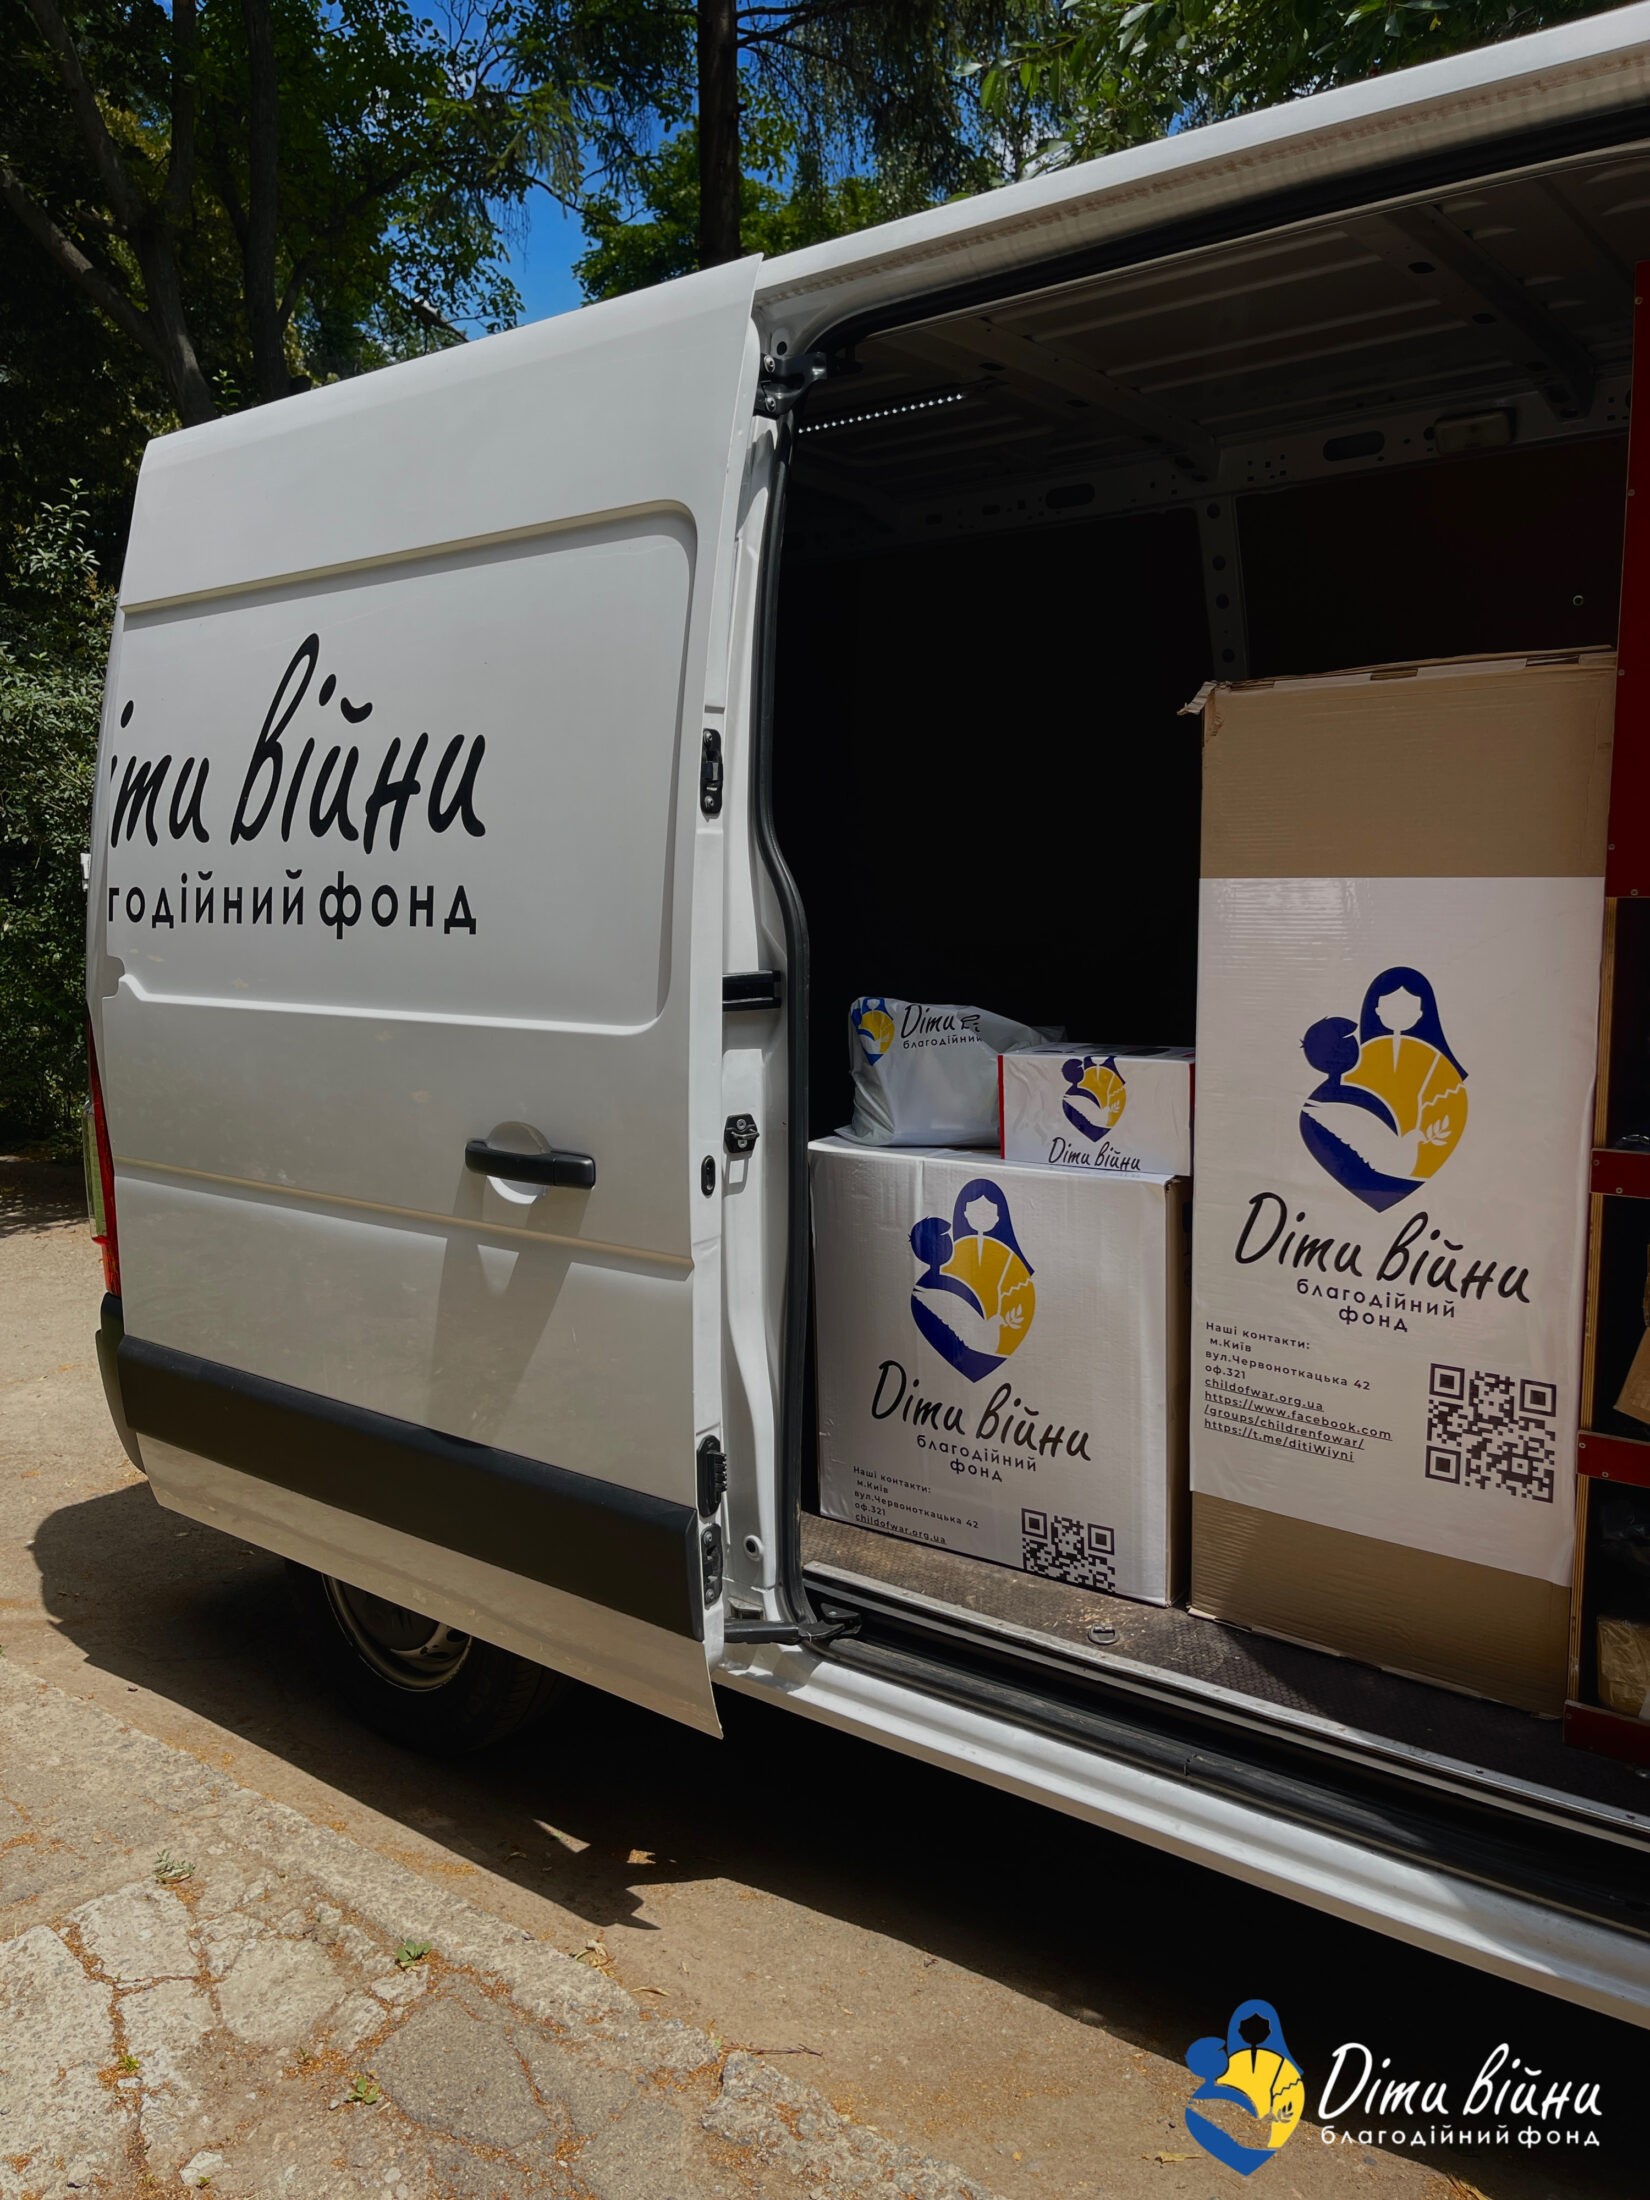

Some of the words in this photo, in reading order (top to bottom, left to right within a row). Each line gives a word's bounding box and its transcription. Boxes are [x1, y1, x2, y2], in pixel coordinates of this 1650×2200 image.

[230, 633, 486, 855] війни
[319, 870, 477, 940] фонд
[901, 1003, 955, 1039] Діти
[1048, 1137, 1091, 1166] Діти
[1094, 1141, 1141, 1171] війни
[1235, 1192, 1363, 1278] Діти
[1376, 1211, 1531, 1304] війни
[1296, 1278, 1457, 1319] благодійний
[1206, 1322, 1238, 1336] Наші
[1242, 1330, 1311, 1350] контакти:
[1338, 1305, 1409, 1333] фонд
[1209, 1337, 1252, 1352] м.Київ
[1205, 1364, 1246, 1380] оф.321
[1353, 1379, 1371, 1391] 42
[871, 1360, 965, 1436] Діти
[975, 1382, 1092, 1462] війни
[1204, 1378, 1325, 1412] childofwar.org.ua
[1204, 1391, 1393, 1441] https://www.facebook.com
[916, 1434, 1037, 1472] благодійний
[853, 1466, 877, 1479] Наші
[880, 1474, 932, 1494] контакти:
[950, 1459, 1003, 1483] фонд
[854, 1502, 886, 1516] оф.321
[966, 1519, 980, 1529] 42
